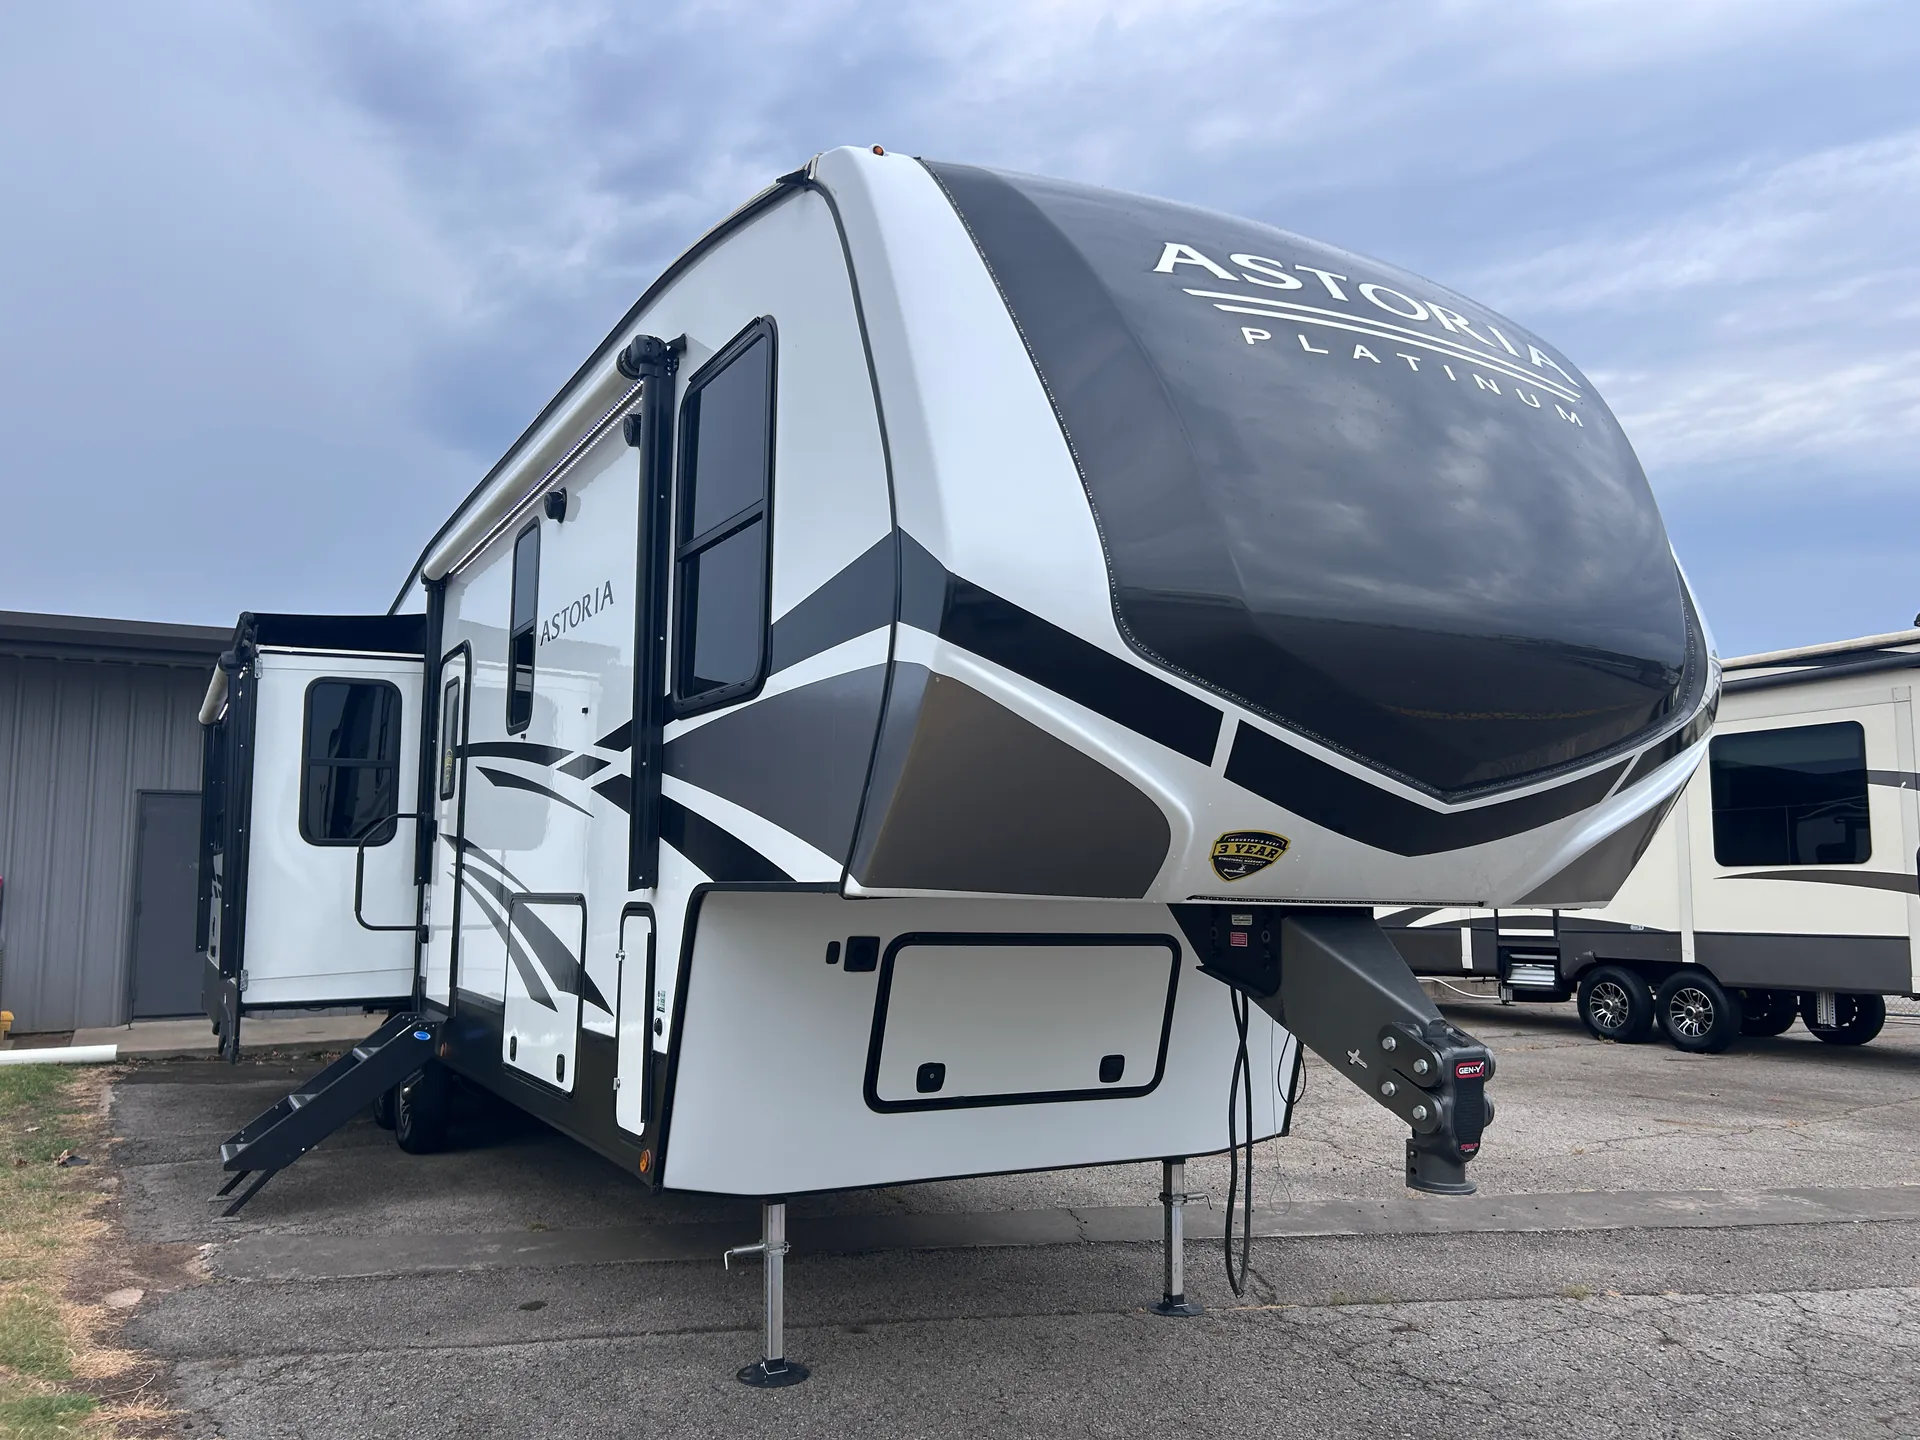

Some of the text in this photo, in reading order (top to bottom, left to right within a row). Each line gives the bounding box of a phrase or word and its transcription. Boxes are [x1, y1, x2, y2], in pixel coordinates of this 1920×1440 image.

[1153, 242, 1581, 387] ASTORIA
[1241, 326, 1584, 427] PLATINUM
[540, 580, 614, 646] ASTORIA
[1218, 844, 1279, 859] 3 YEAR
[1458, 1061, 1484, 1075] GEN-Y
